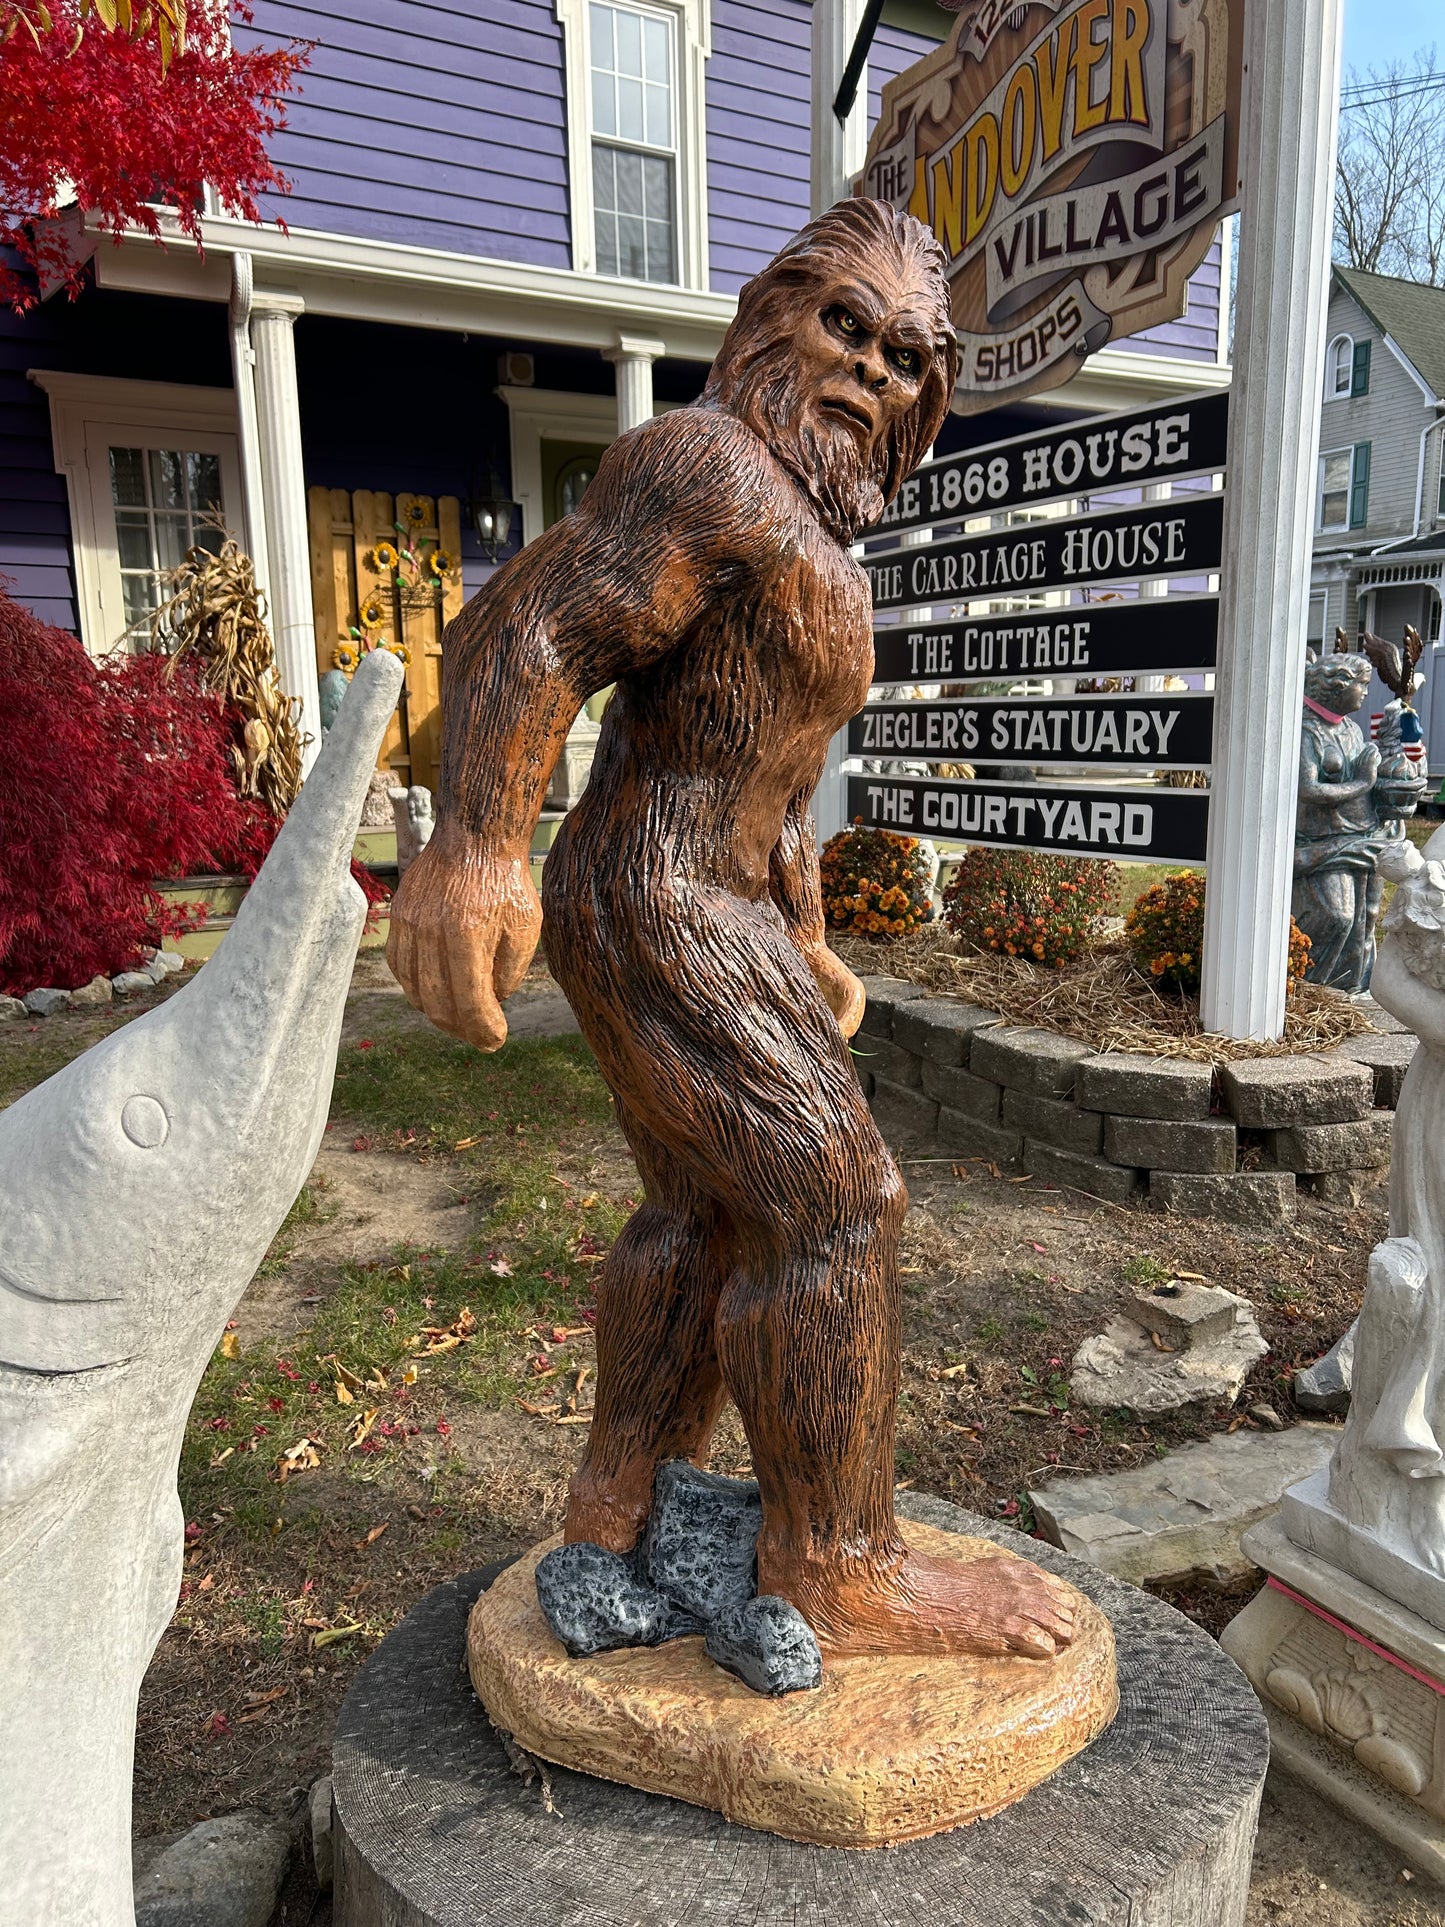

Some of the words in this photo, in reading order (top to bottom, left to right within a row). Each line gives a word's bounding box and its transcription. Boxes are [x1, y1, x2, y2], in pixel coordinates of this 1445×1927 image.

[868, 154, 908, 200] THE
[994, 142, 1207, 280] VILLAGE
[974, 295, 1083, 383] SHOPS
[929, 456, 1010, 513] 1868
[1022, 413, 1190, 492] HOUSE
[911, 540, 1047, 596] CARRIAGE
[1062, 518, 1187, 576] HOUSE
[908, 633, 953, 674] THE
[964, 622, 1091, 671] COTTAGE
[862, 708, 980, 750] ZIEGLER'S
[991, 710, 1182, 755] STATUARY
[867, 786, 915, 824] THE
[922, 791, 1154, 846] COURTYARD
